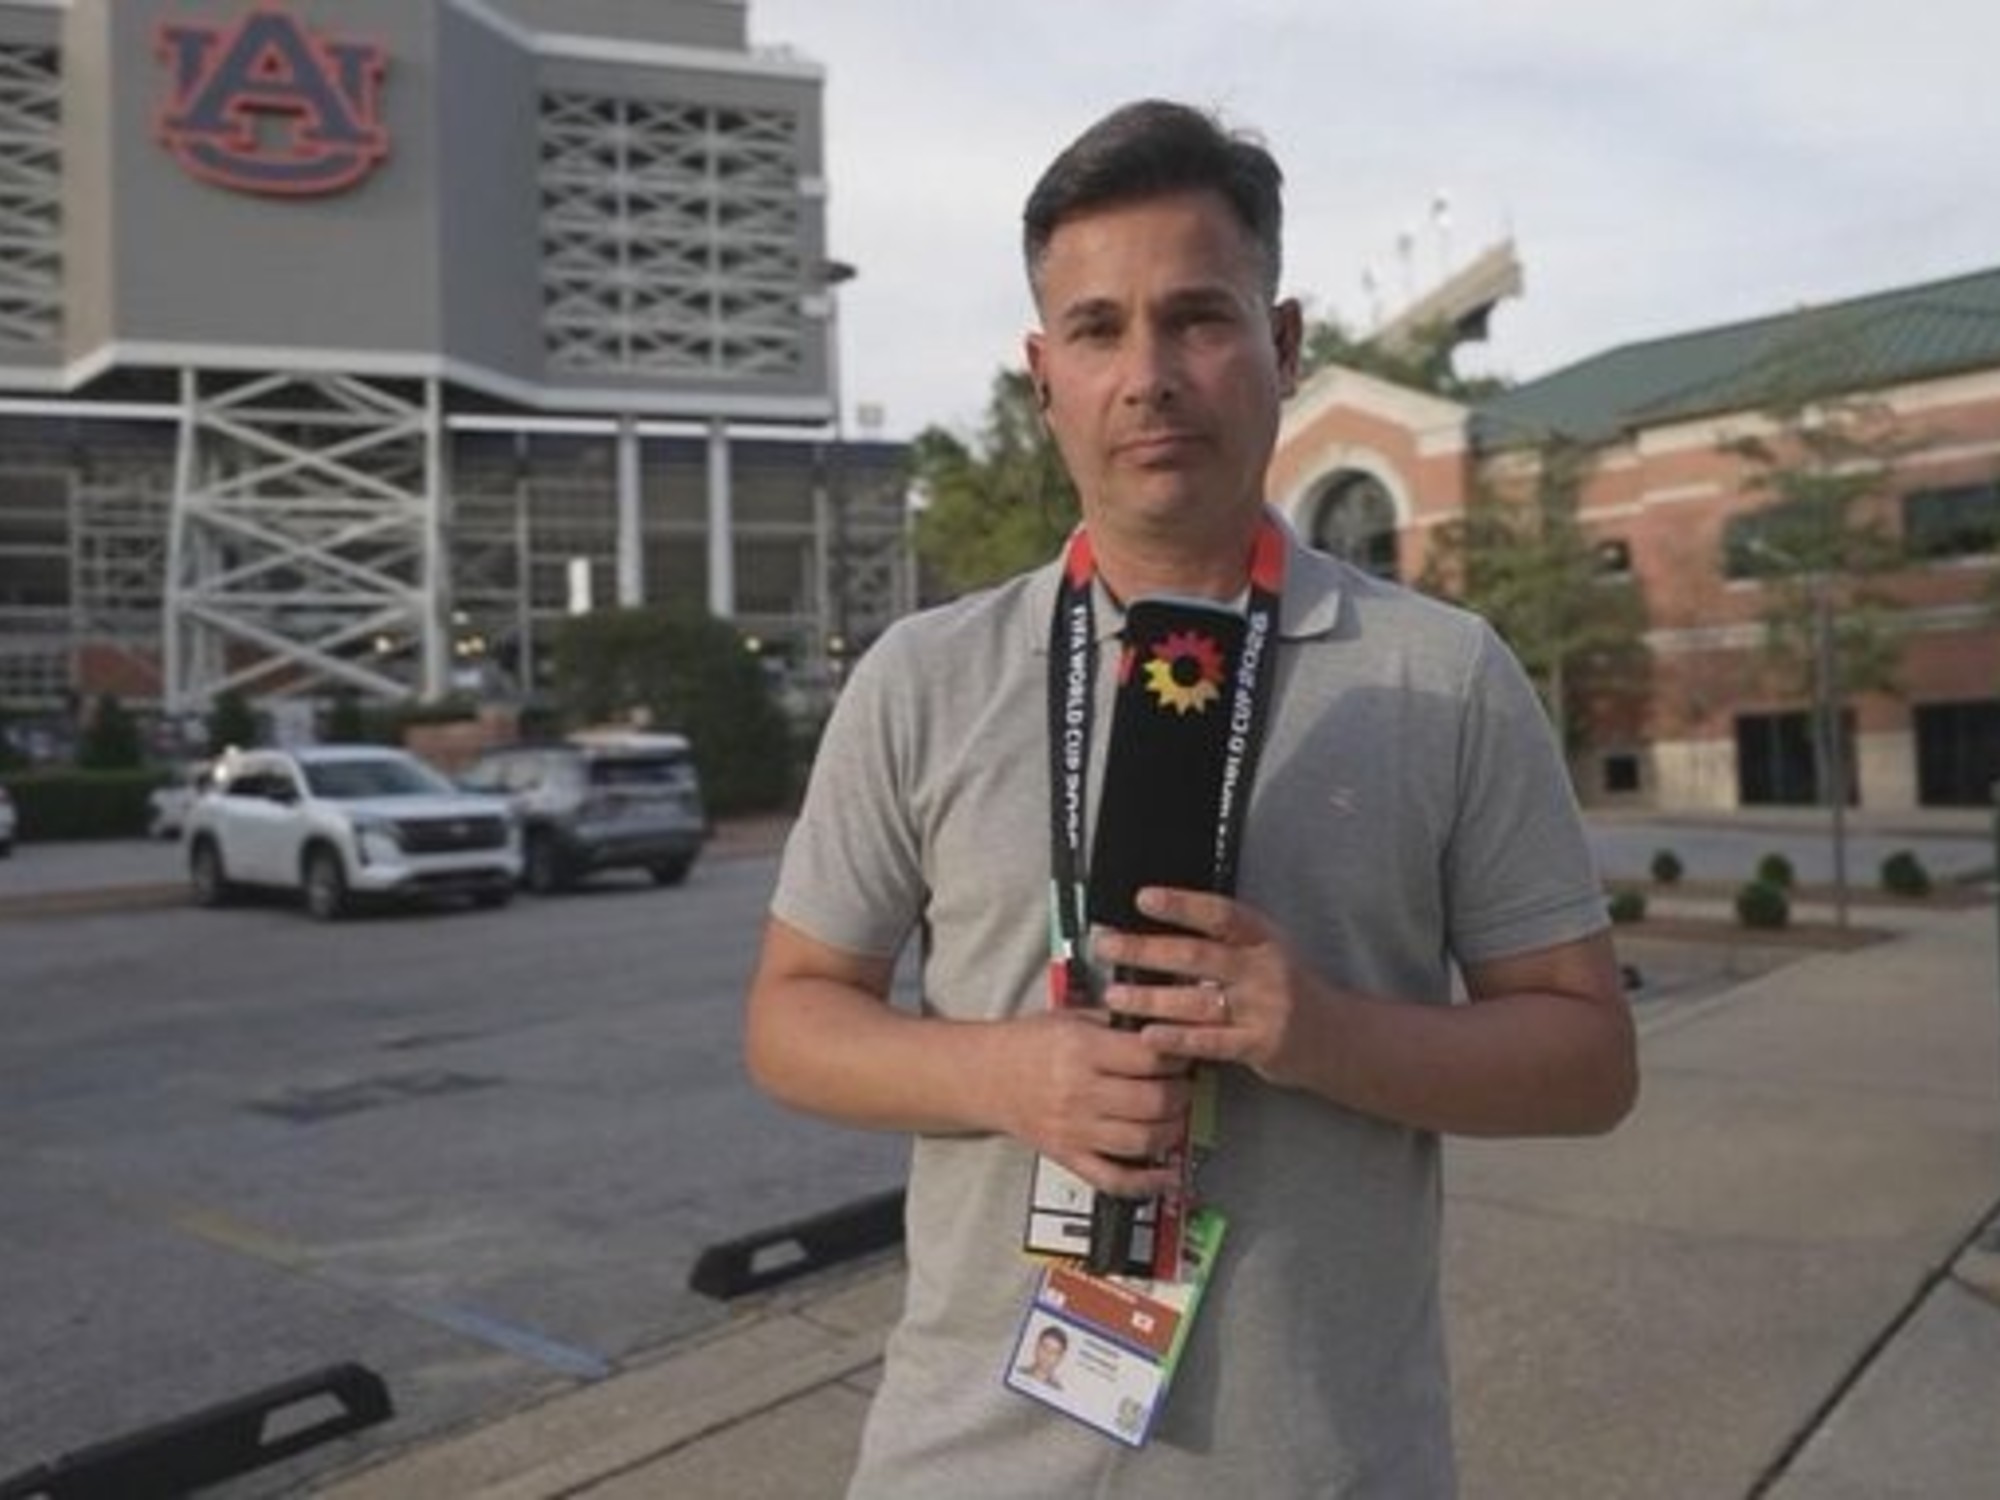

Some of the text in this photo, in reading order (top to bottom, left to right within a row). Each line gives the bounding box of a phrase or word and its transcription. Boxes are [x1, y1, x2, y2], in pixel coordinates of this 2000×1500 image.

[1069, 604, 1088, 649] FIFA
[1236, 611, 1269, 688] 2026
[1065, 651, 1086, 725] WORLD
[1230, 689, 1253, 734] CUP
[1065, 728, 1084, 771] CUP
